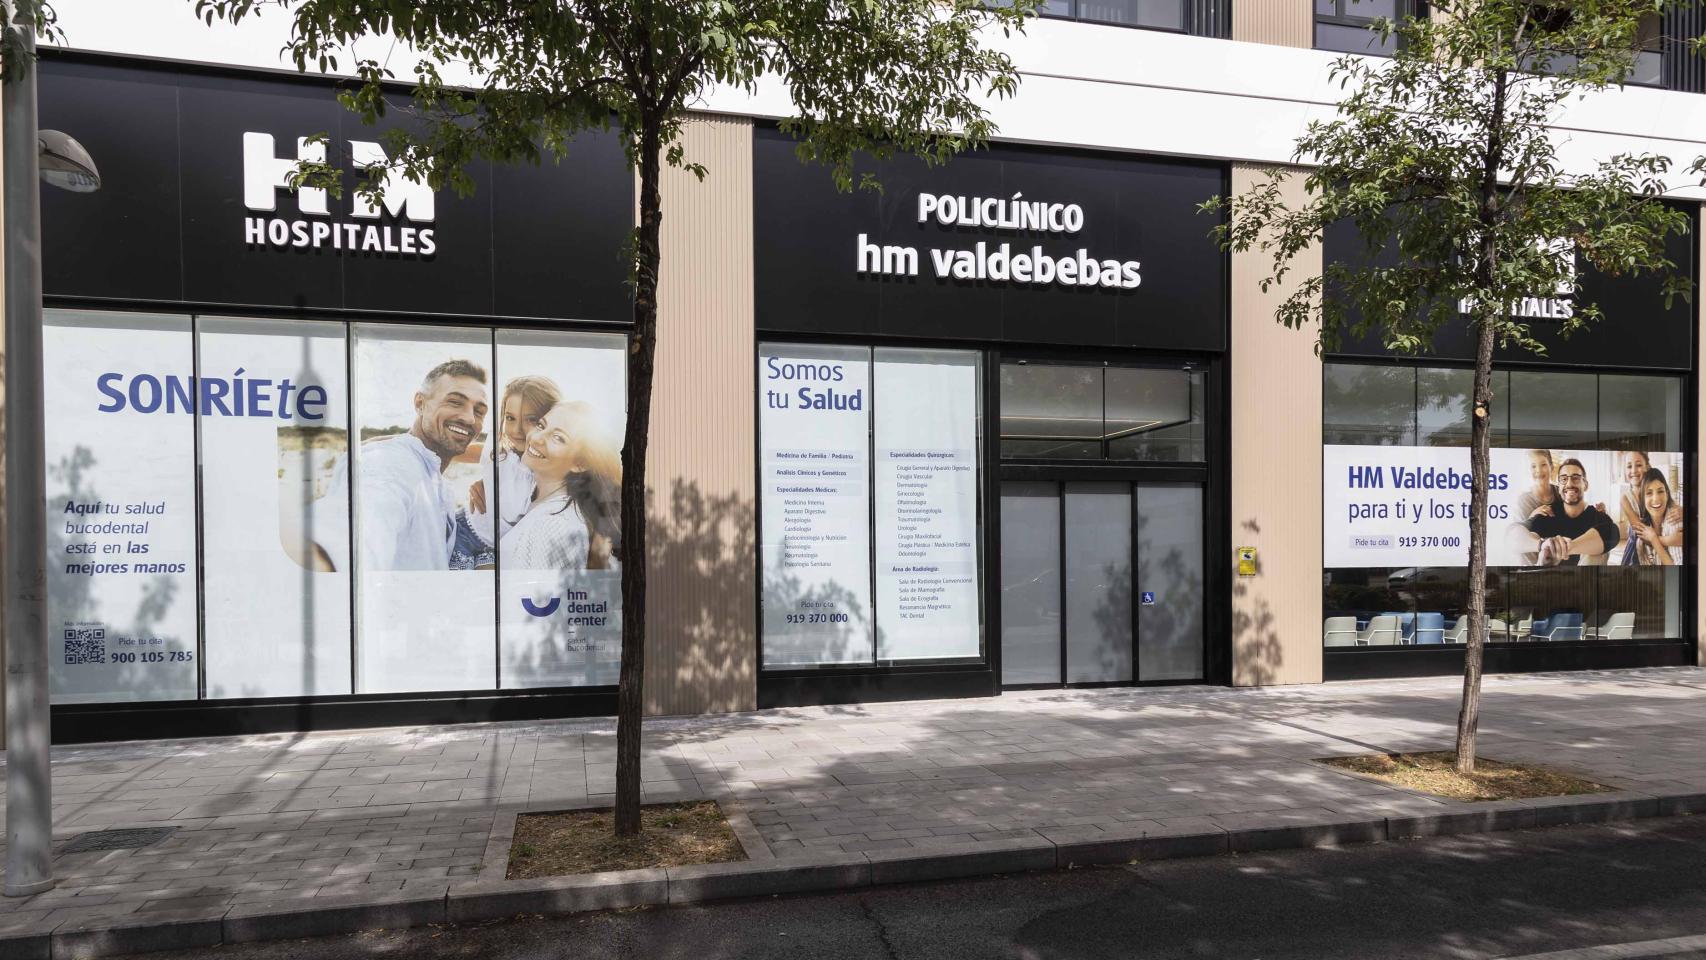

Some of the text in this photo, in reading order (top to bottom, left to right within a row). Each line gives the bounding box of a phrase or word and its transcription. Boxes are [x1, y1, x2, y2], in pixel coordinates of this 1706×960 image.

[243, 131, 435, 223] HM
[918, 191, 1084, 233] POLICLÍNICO
[244, 217, 436, 255] HOSPITALES
[857, 233, 1142, 288] hm valdebebas
[767, 356, 844, 382] Somos
[96, 367, 328, 420] SONRÍEte
[767, 387, 862, 411] tu Salud
[889, 451, 926, 459] Especialidades
[1348, 466, 1509, 491] HM Valdebeas
[776, 486, 814, 494] Especialidades
[64, 500, 166, 517] Aquí tu salud
[1349, 502, 1389, 524] para
[1395, 498, 1406, 519] ti
[1412, 503, 1424, 524] y
[1430, 498, 1455, 519] los
[65, 521, 149, 535] bucodental
[65, 540, 150, 555] está en las
[1355, 537, 1389, 546] Pide tu cita
[1398, 536, 1460, 548] 919 370 000
[65, 560, 187, 577] mejores manos
[567, 588, 588, 601] hm
[567, 601, 607, 614] dental
[567, 615, 607, 627] center
[786, 613, 848, 624] 919 370 000
[118, 637, 163, 646] Pide tu cita
[110, 650, 193, 664] 900 105 785
